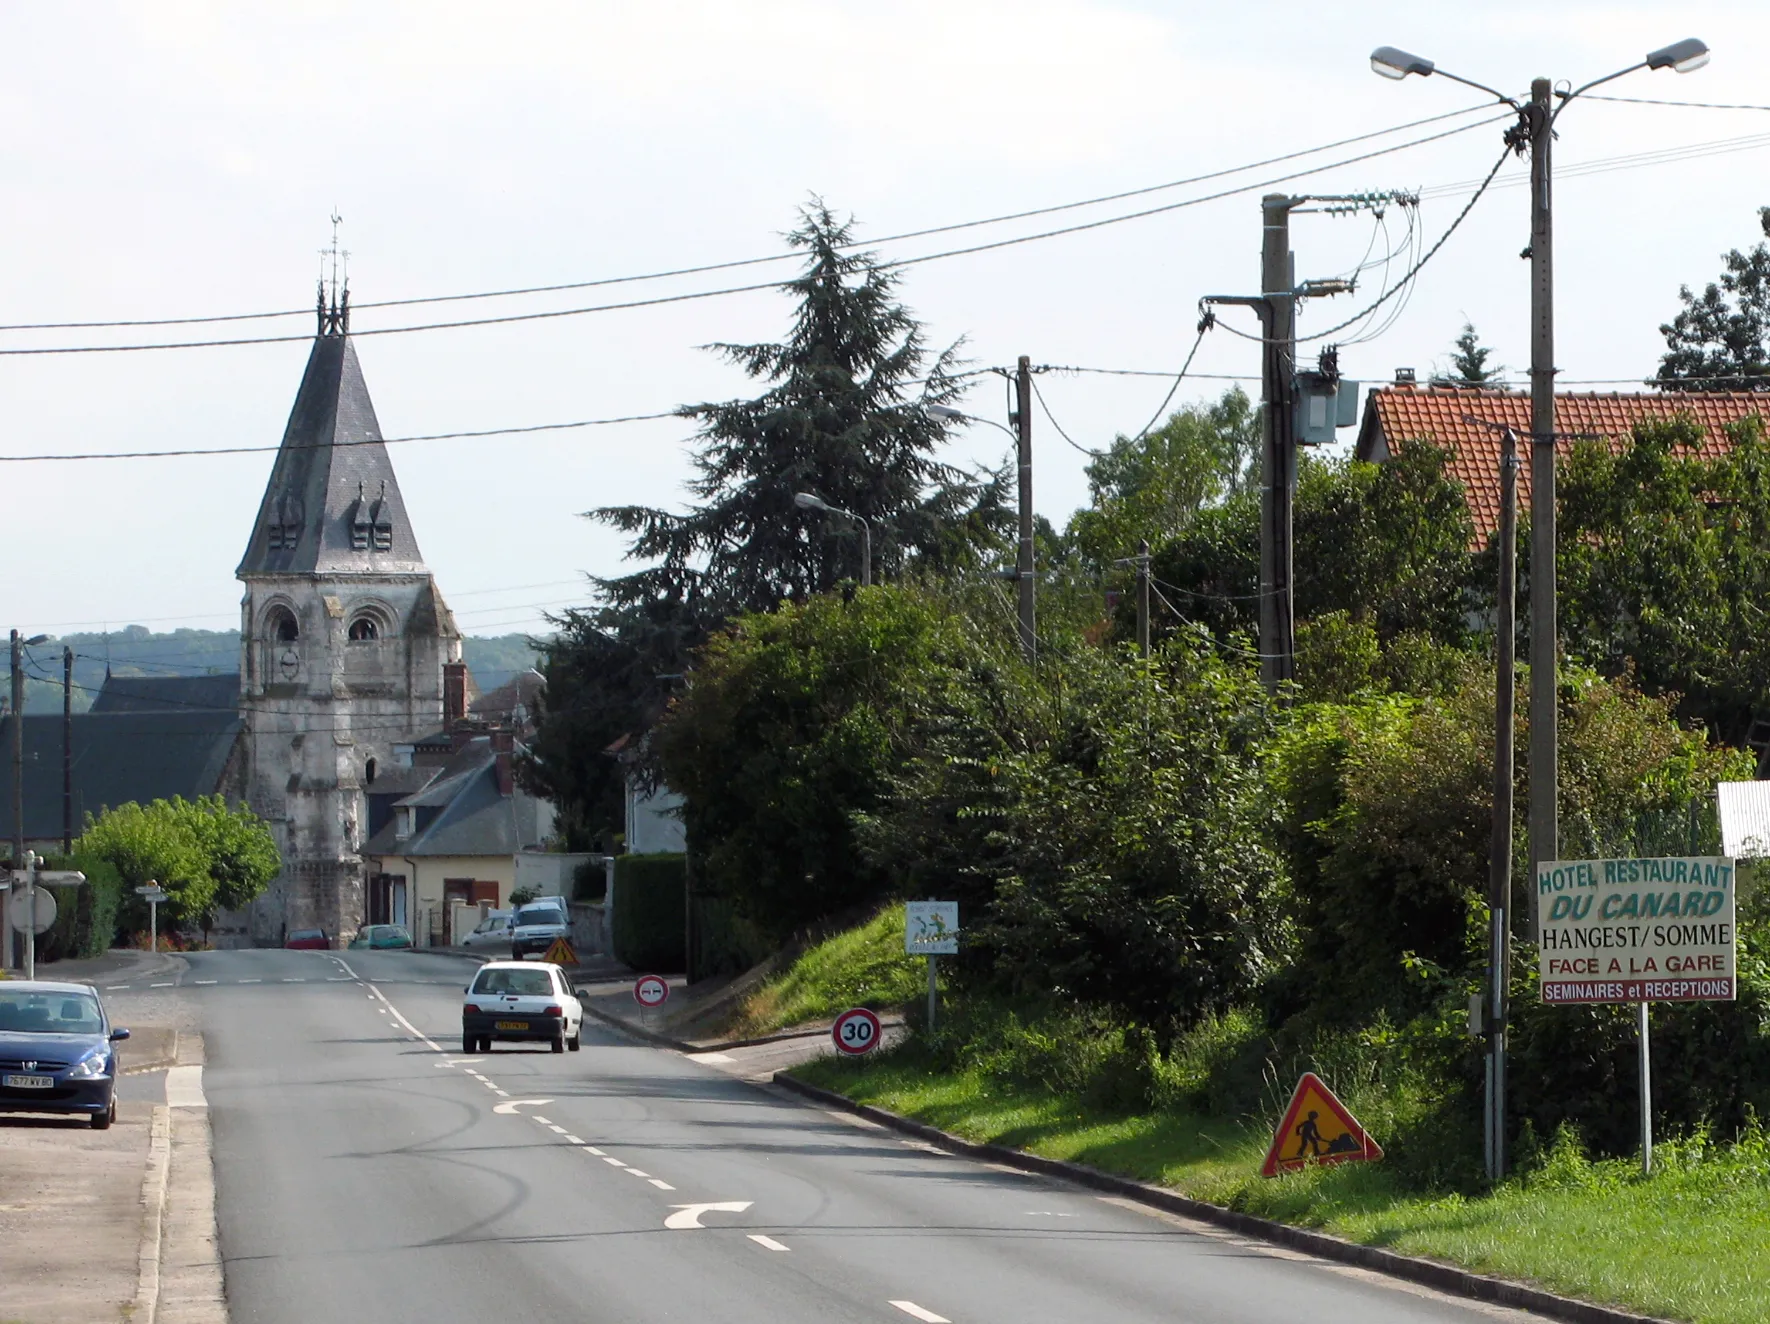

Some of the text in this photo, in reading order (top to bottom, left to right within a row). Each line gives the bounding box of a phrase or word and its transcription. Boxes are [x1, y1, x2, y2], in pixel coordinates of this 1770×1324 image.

[1539, 859, 1732, 895] HOTEL RESTAURANT
[1548, 891, 1724, 921] DU CANARD
[1550, 955, 1724, 973] FACE A LA GARE
[1545, 981, 1729, 1000] SEMINAIRES et RECEPTIONS
[844, 1023, 871, 1041] 30
